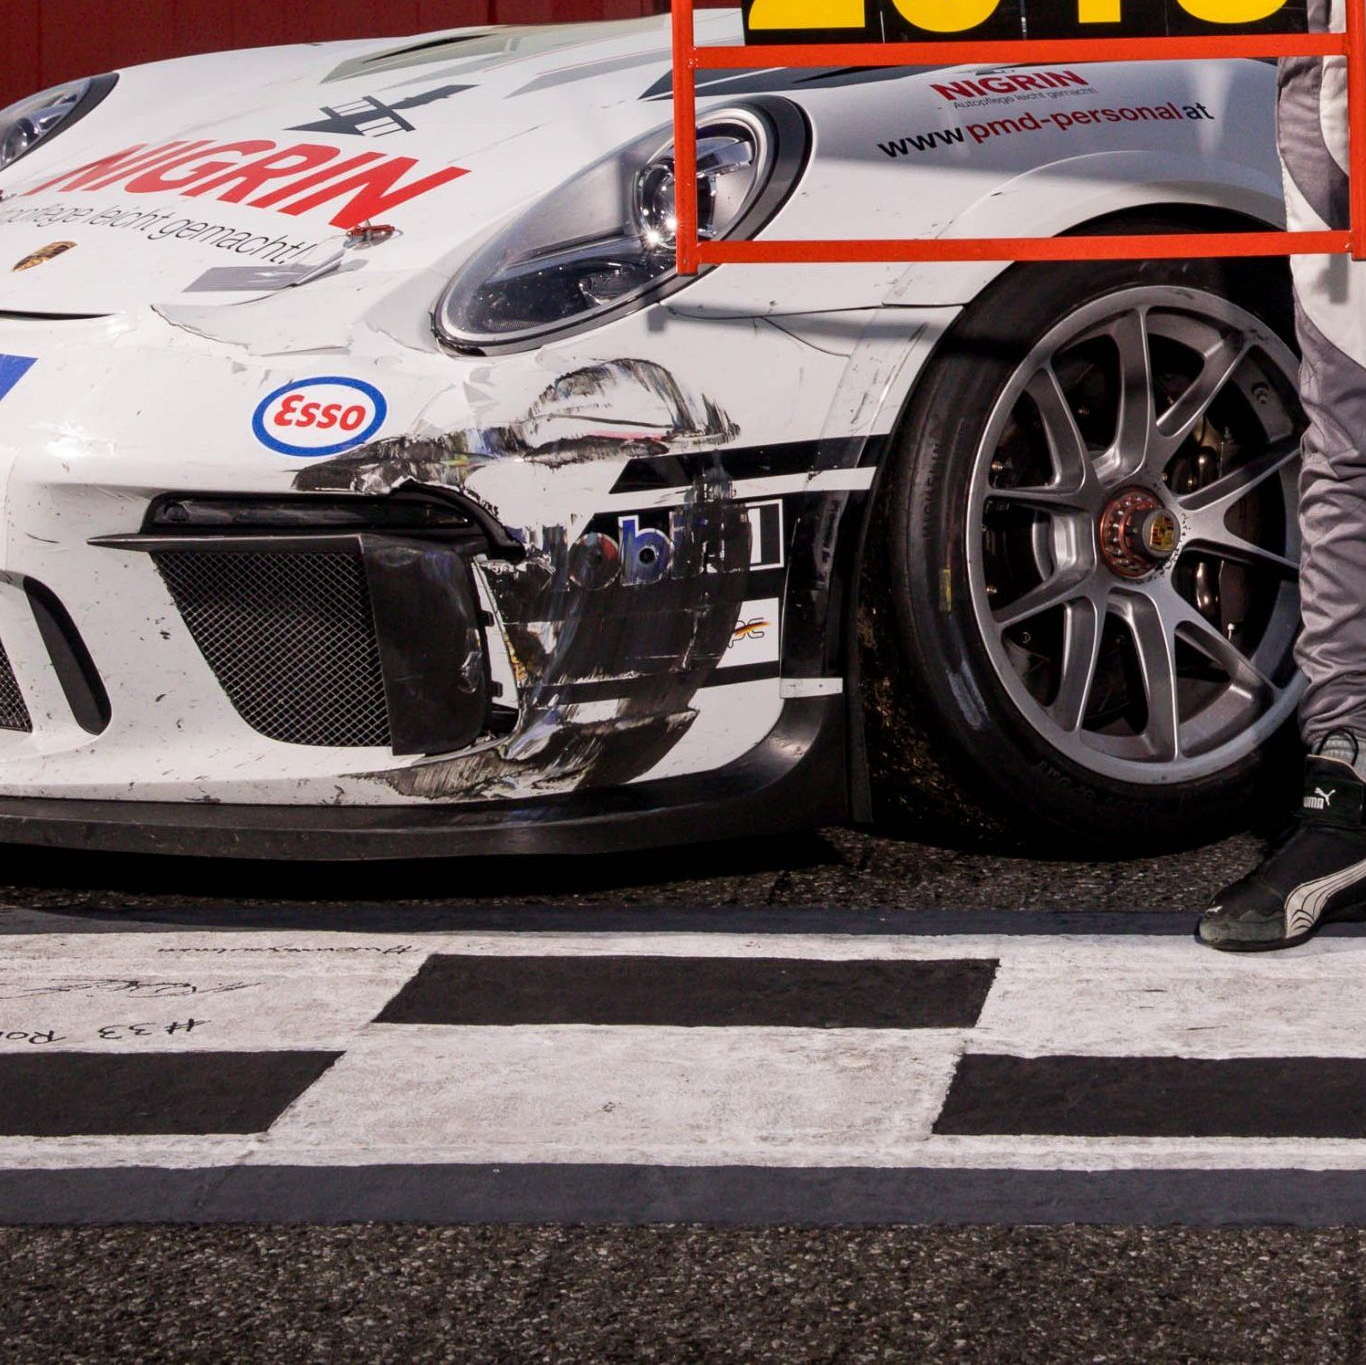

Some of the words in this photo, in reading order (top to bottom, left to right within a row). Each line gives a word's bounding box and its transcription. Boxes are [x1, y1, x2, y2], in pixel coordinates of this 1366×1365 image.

[931, 70, 1089, 100] NIGRIN
[26, 139, 471, 229] NIGRIN
[148, 218, 317, 264] gemacht!
[1302, 796, 1324, 810] UMA
[0, 1029, 66, 1045] Ro
